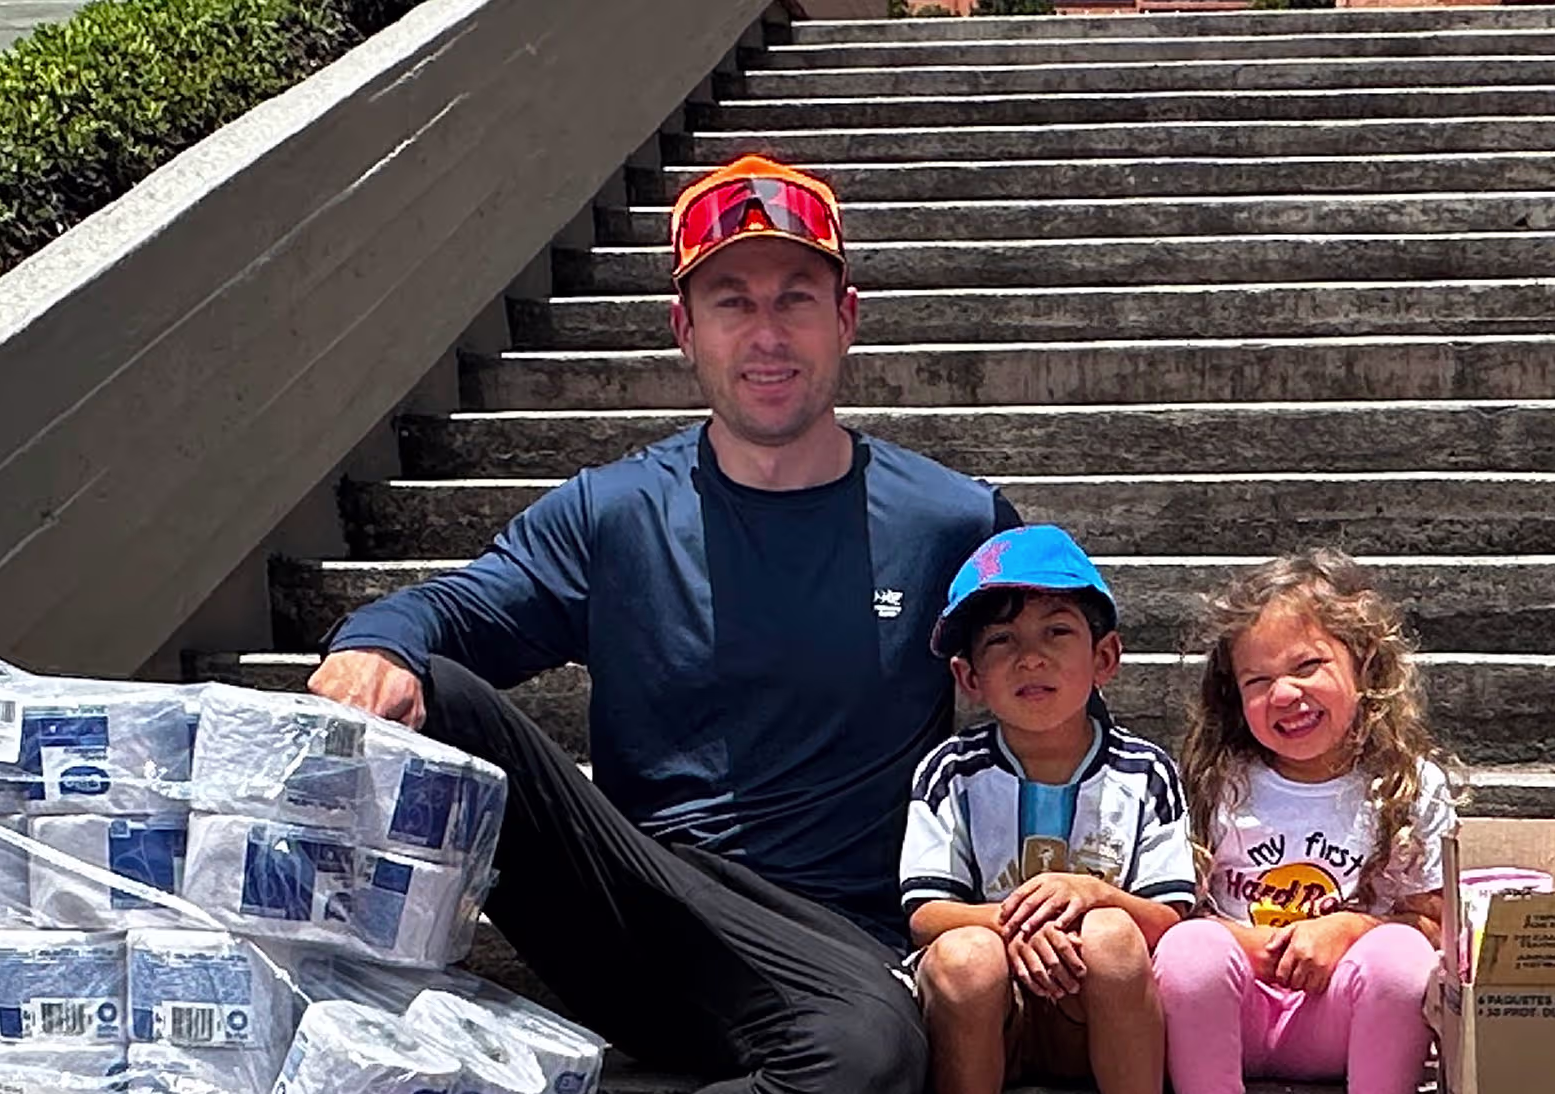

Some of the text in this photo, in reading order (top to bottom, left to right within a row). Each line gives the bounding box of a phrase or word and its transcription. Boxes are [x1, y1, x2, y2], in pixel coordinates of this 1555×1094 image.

[1248, 832, 1364, 876] my first
[1226, 868, 1299, 908] Hard
[1488, 996, 1552, 1006] PAQUETES
